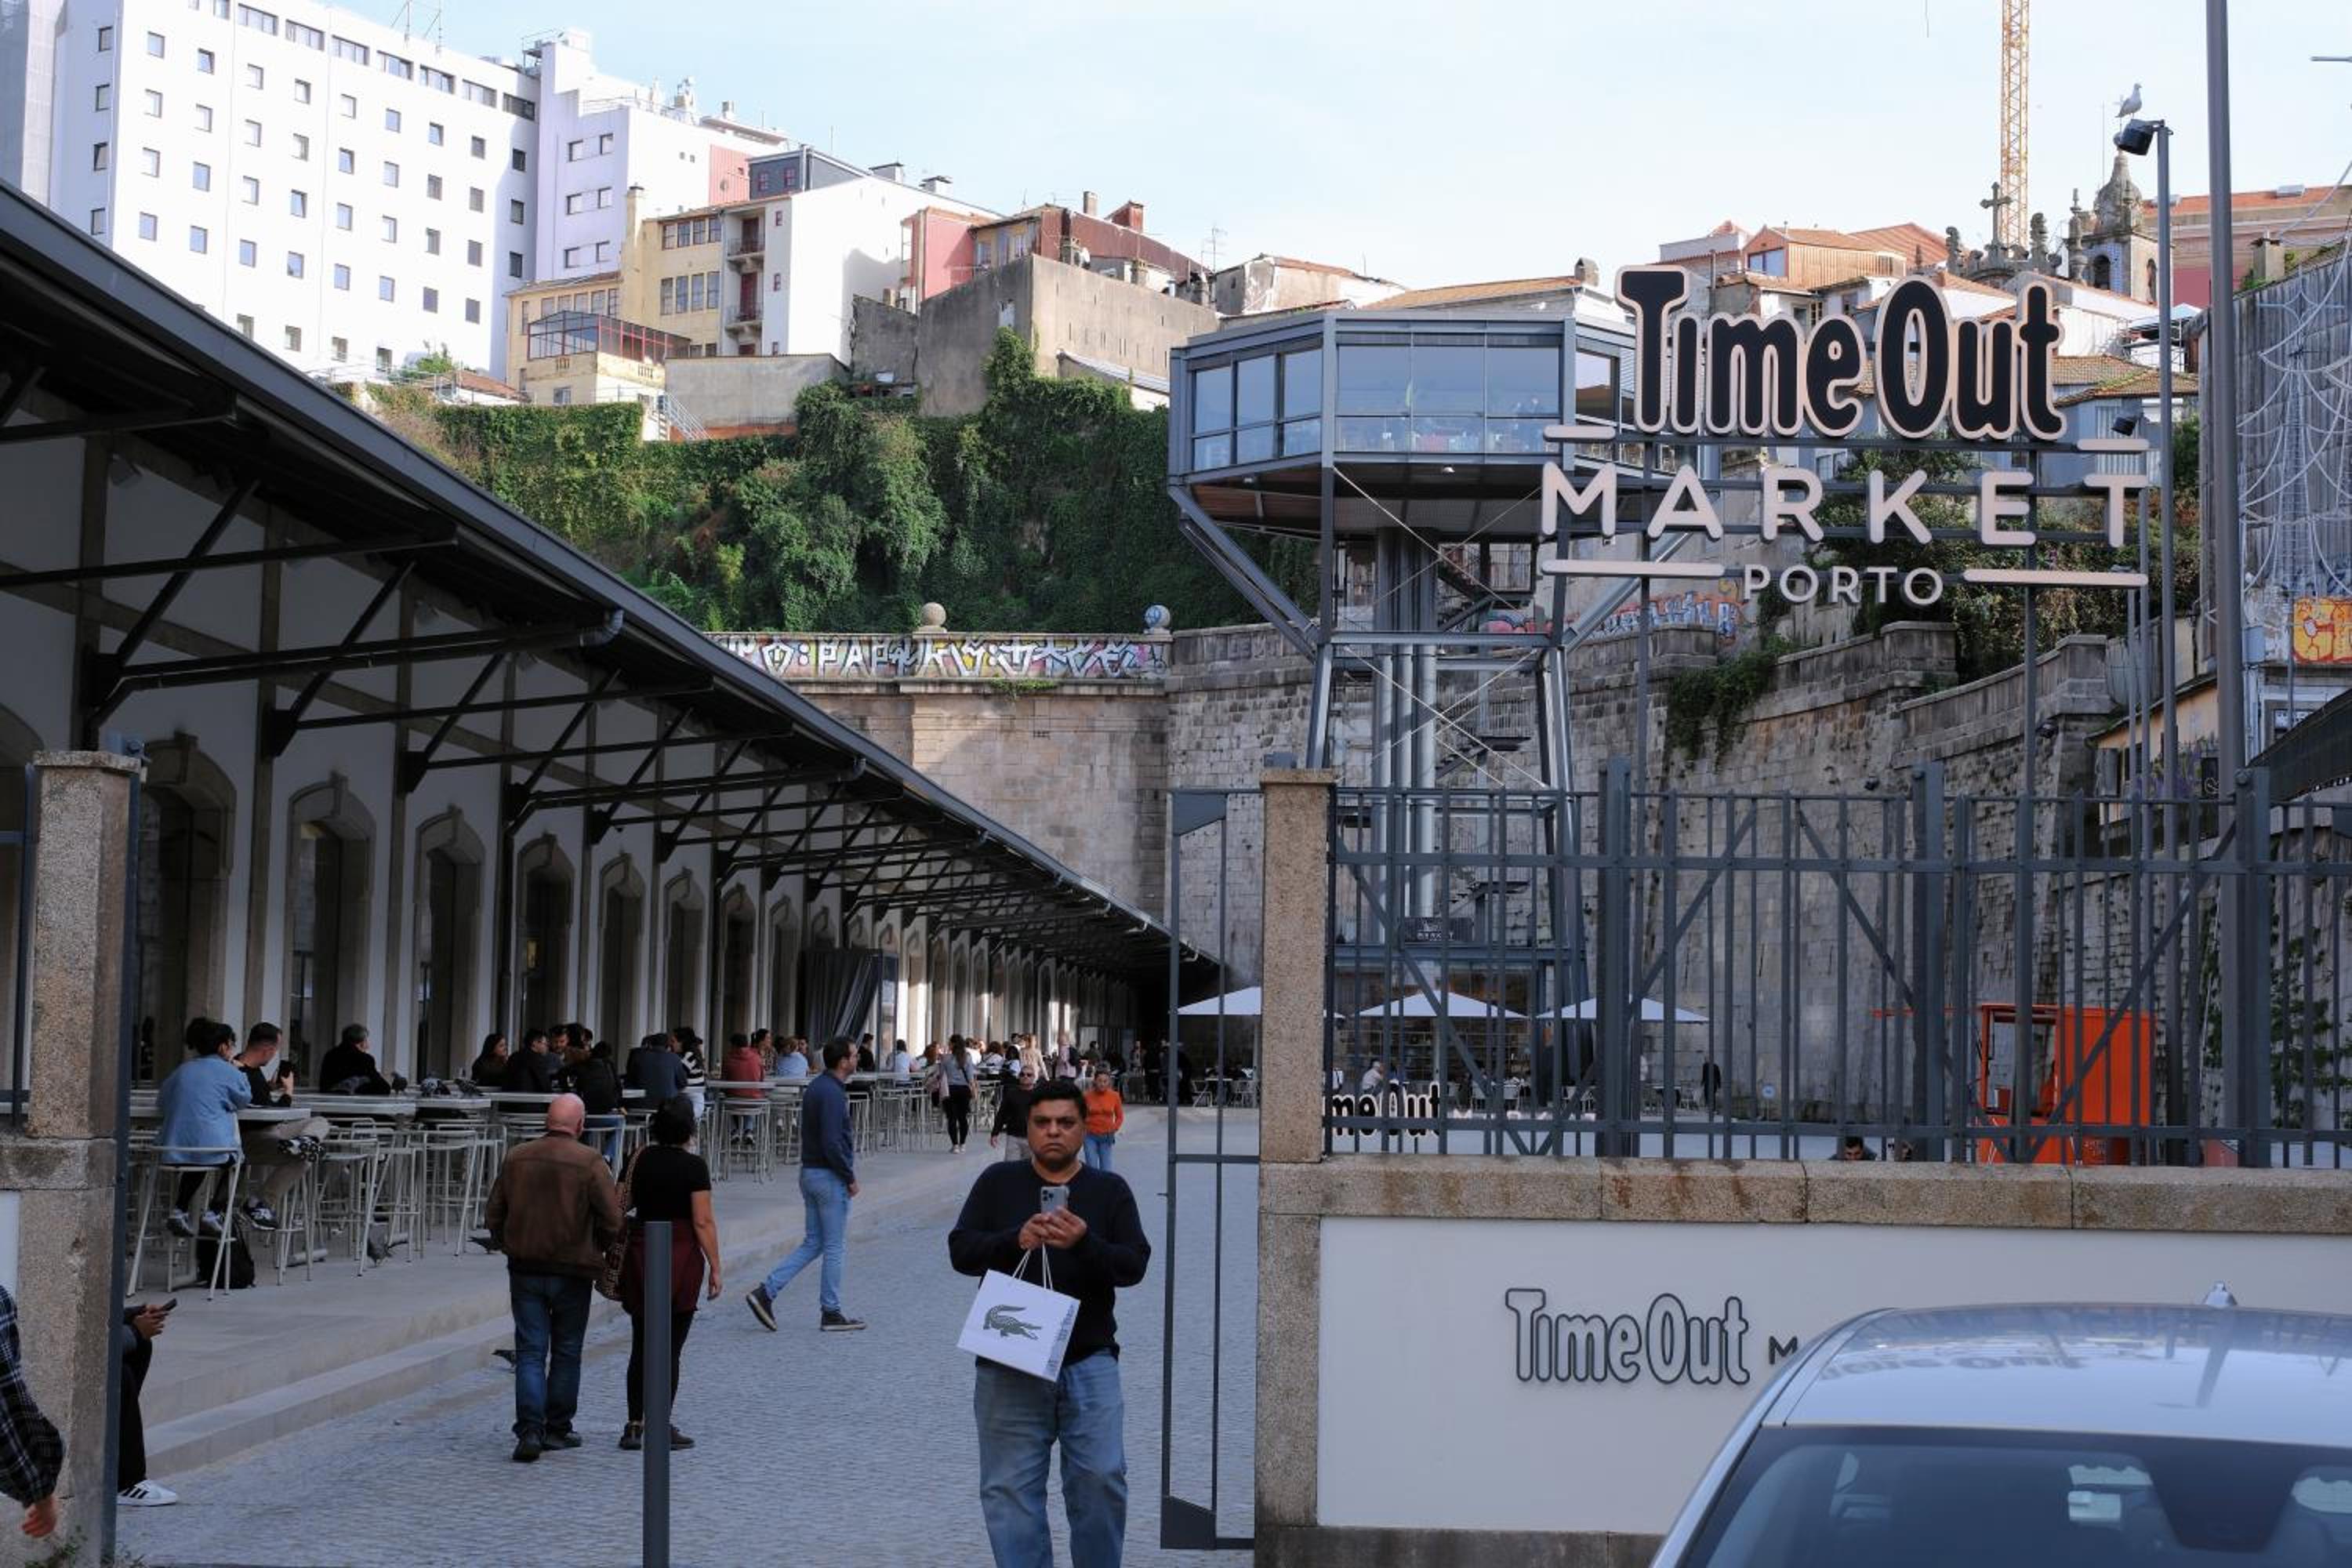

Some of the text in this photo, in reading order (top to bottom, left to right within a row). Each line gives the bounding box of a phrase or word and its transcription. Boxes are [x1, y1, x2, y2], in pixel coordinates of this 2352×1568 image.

[1876, 274, 2067, 441] Out
[1541, 461, 2148, 548] MARKET
[1743, 564, 1944, 606] PORTO
